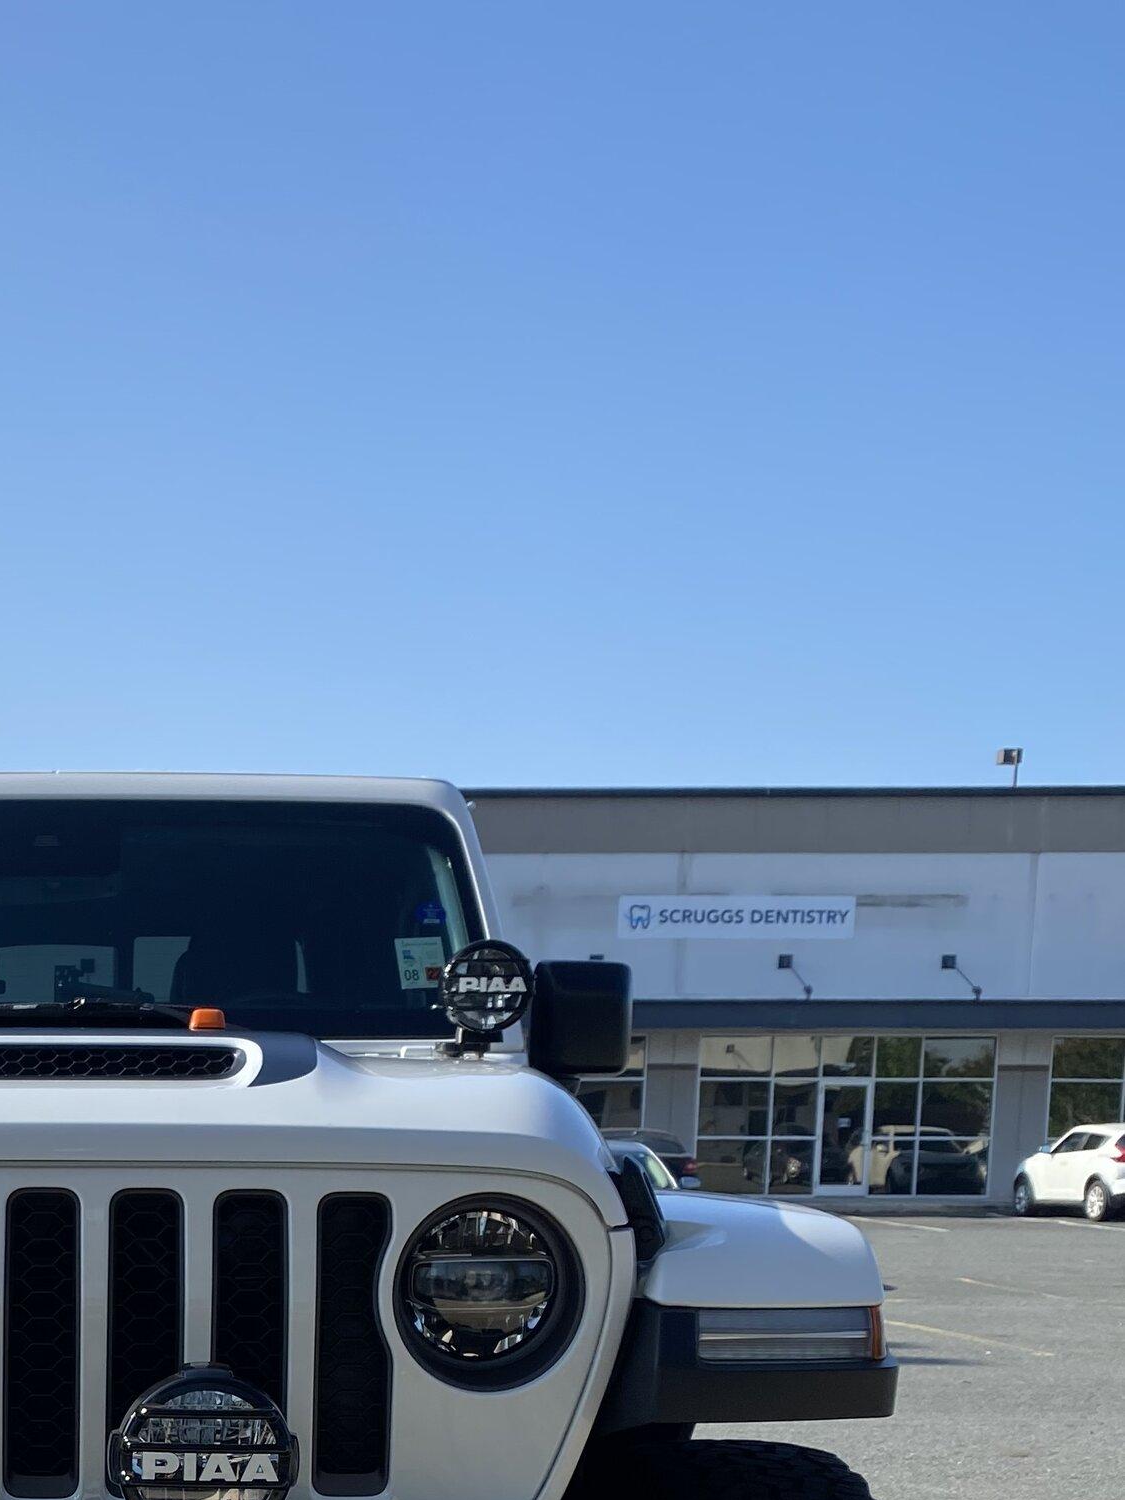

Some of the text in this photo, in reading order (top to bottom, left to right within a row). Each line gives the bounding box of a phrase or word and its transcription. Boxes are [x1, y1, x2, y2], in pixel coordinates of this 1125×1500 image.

[658, 909, 850, 925] SCRUGGS DENTISTRY
[404, 969, 420, 981] 08
[458, 976, 527, 993] PIAA
[141, 1451, 279, 1482] PIAA
